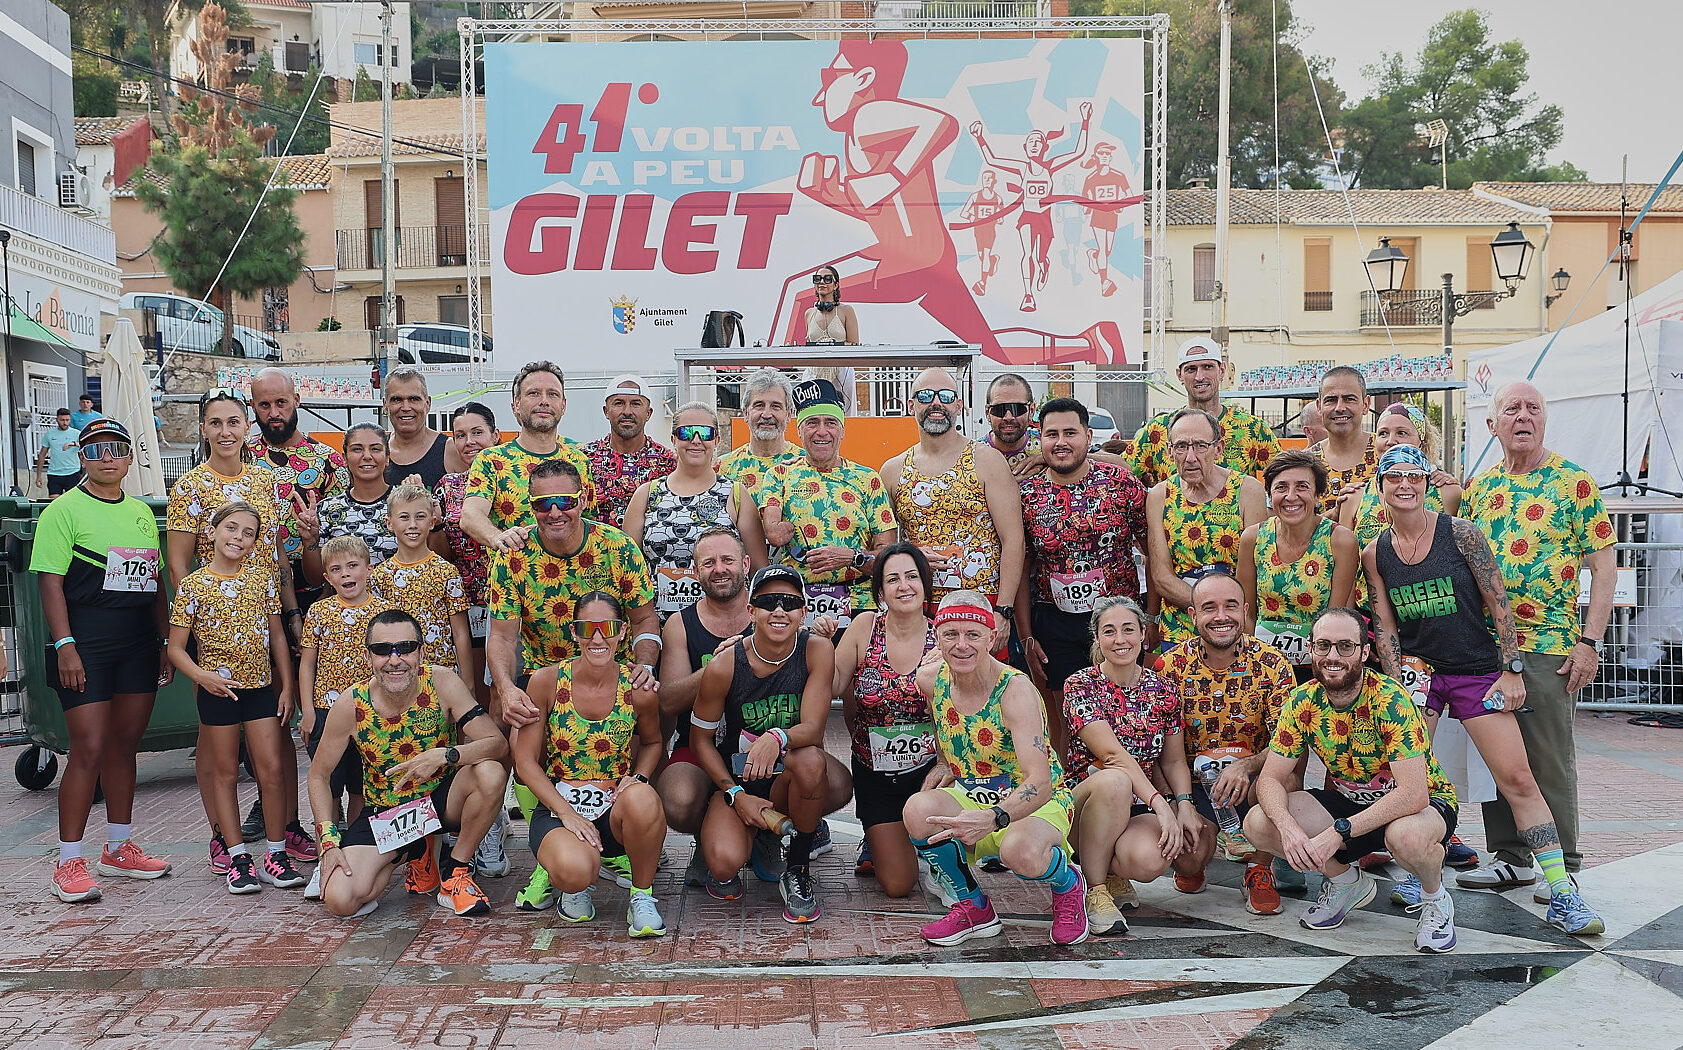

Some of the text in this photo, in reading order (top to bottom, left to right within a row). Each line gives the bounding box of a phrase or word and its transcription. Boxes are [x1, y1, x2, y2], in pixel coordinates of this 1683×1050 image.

[630, 125, 800, 152] VOLTA
[579, 159, 745, 186] A PEU
[1028, 185, 1045, 195] 08
[1097, 188, 1114, 198] 25
[503, 191, 793, 276] GILET
[26, 289, 42, 324] La
[50, 297, 94, 337] Baronía
[639, 308, 688, 317] Ajuntament
[654, 318, 674, 326] Gilet
[795, 385, 818, 402] Buff
[122, 561, 147, 577] 176
[669, 582, 702, 597] 348
[1063, 584, 1092, 600] 189
[1389, 576, 1454, 606] GREEN
[807, 598, 838, 613] 564
[1396, 595, 1458, 623] POWER
[936, 612, 987, 622] RUNNERS
[1271, 635, 1302, 652] 471
[741, 693, 802, 720] GREEN
[886, 738, 921, 755] 426
[569, 788, 604, 807] 323
[577, 806, 595, 814] Neus
[389, 808, 417, 833] 177
